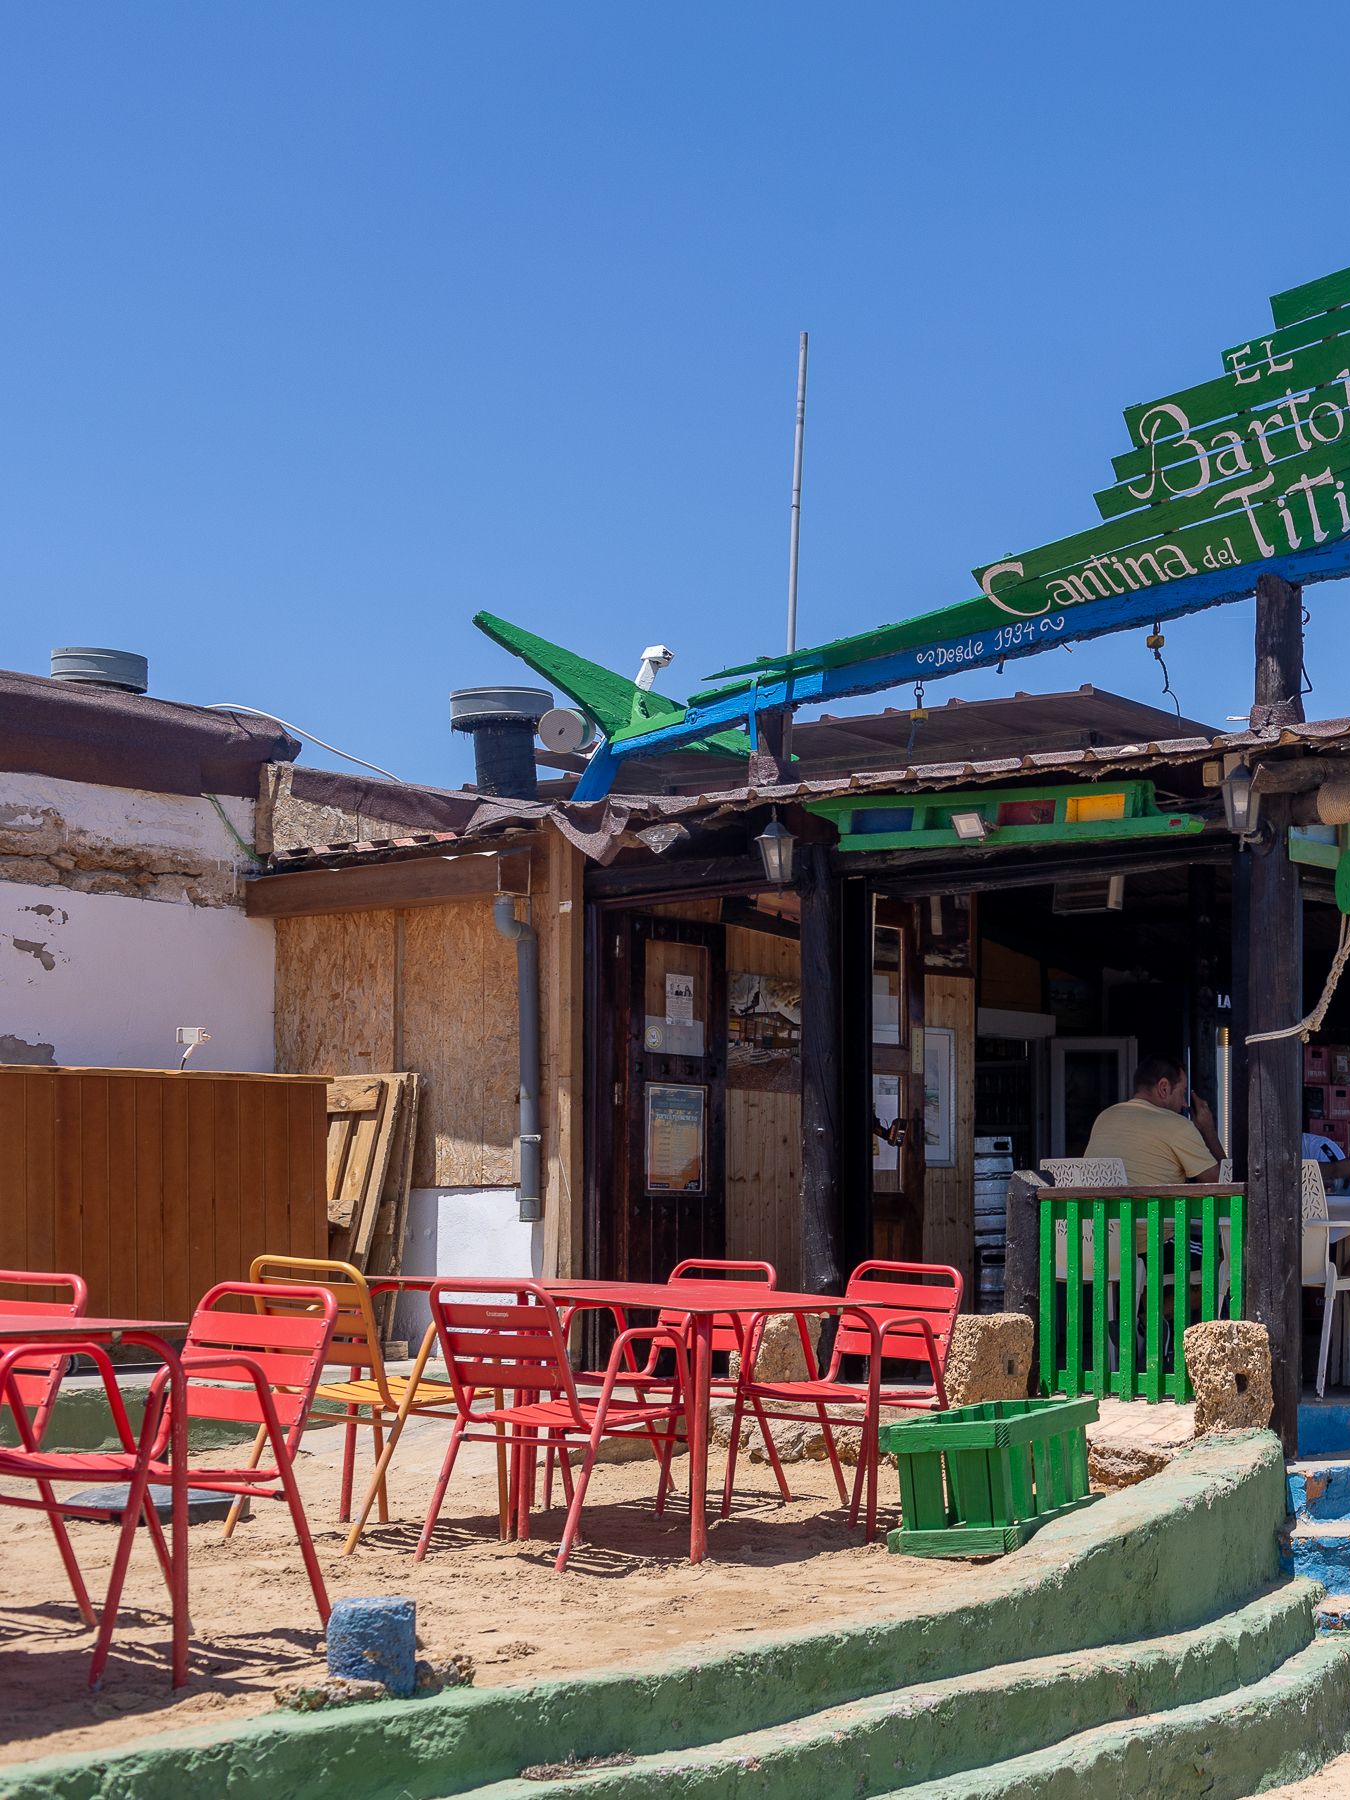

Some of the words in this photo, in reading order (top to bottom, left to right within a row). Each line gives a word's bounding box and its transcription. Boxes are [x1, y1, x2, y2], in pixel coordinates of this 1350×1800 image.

[1227, 340, 1293, 387] EL
[981, 543, 1198, 617] Cantina
[1202, 537, 1241, 569] del
[935, 638, 985, 668] Desde
[994, 621, 1036, 651] 1934
